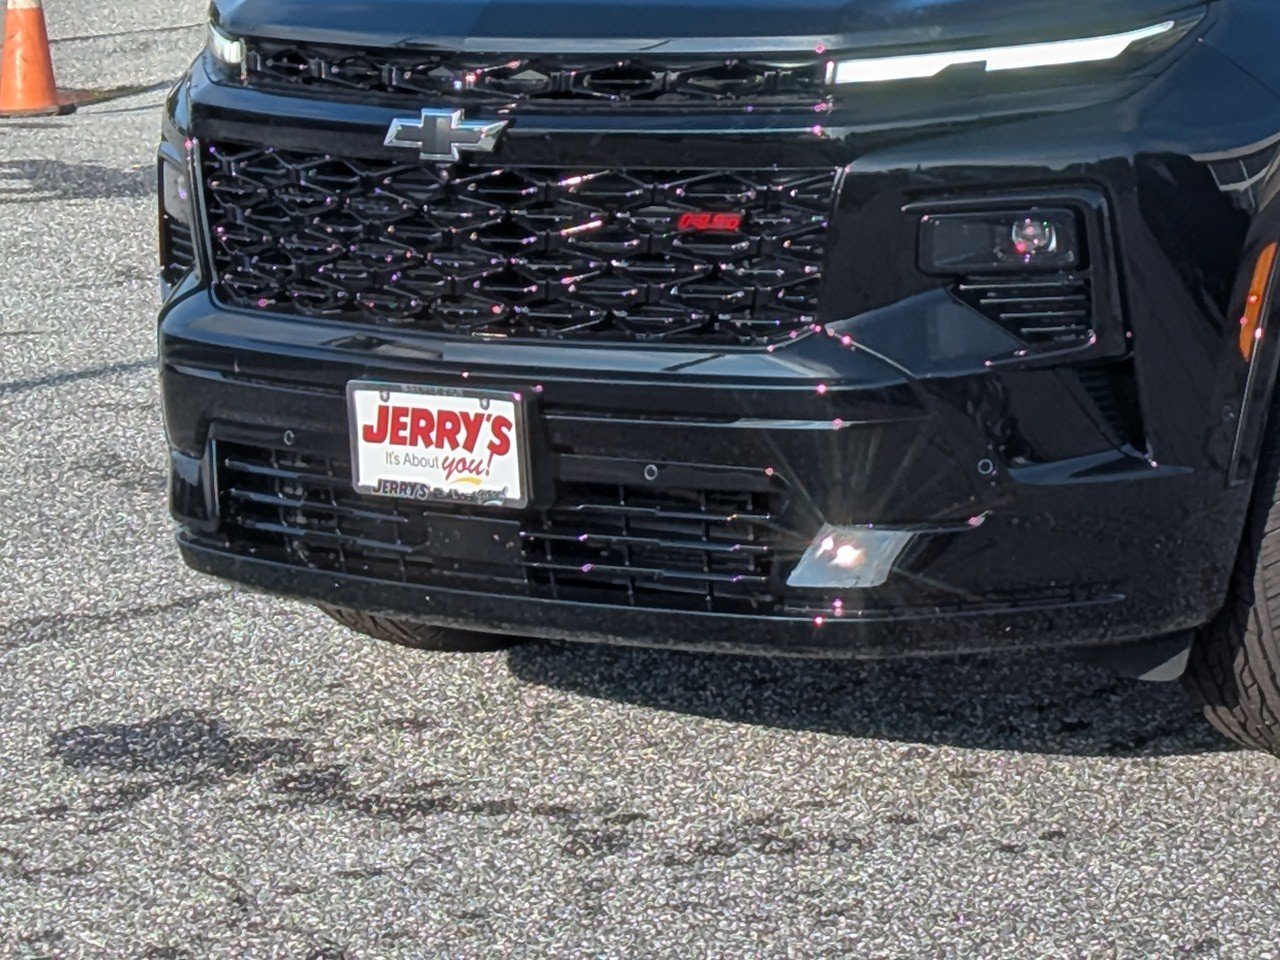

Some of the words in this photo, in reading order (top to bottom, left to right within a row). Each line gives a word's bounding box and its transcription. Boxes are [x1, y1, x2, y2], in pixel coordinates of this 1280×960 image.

[362, 405, 513, 456] JERRY'S
[385, 451, 400, 466] It's
[403, 452, 439, 469] About
[441, 452, 494, 481] you!
[372, 479, 430, 500] JERRY'S
